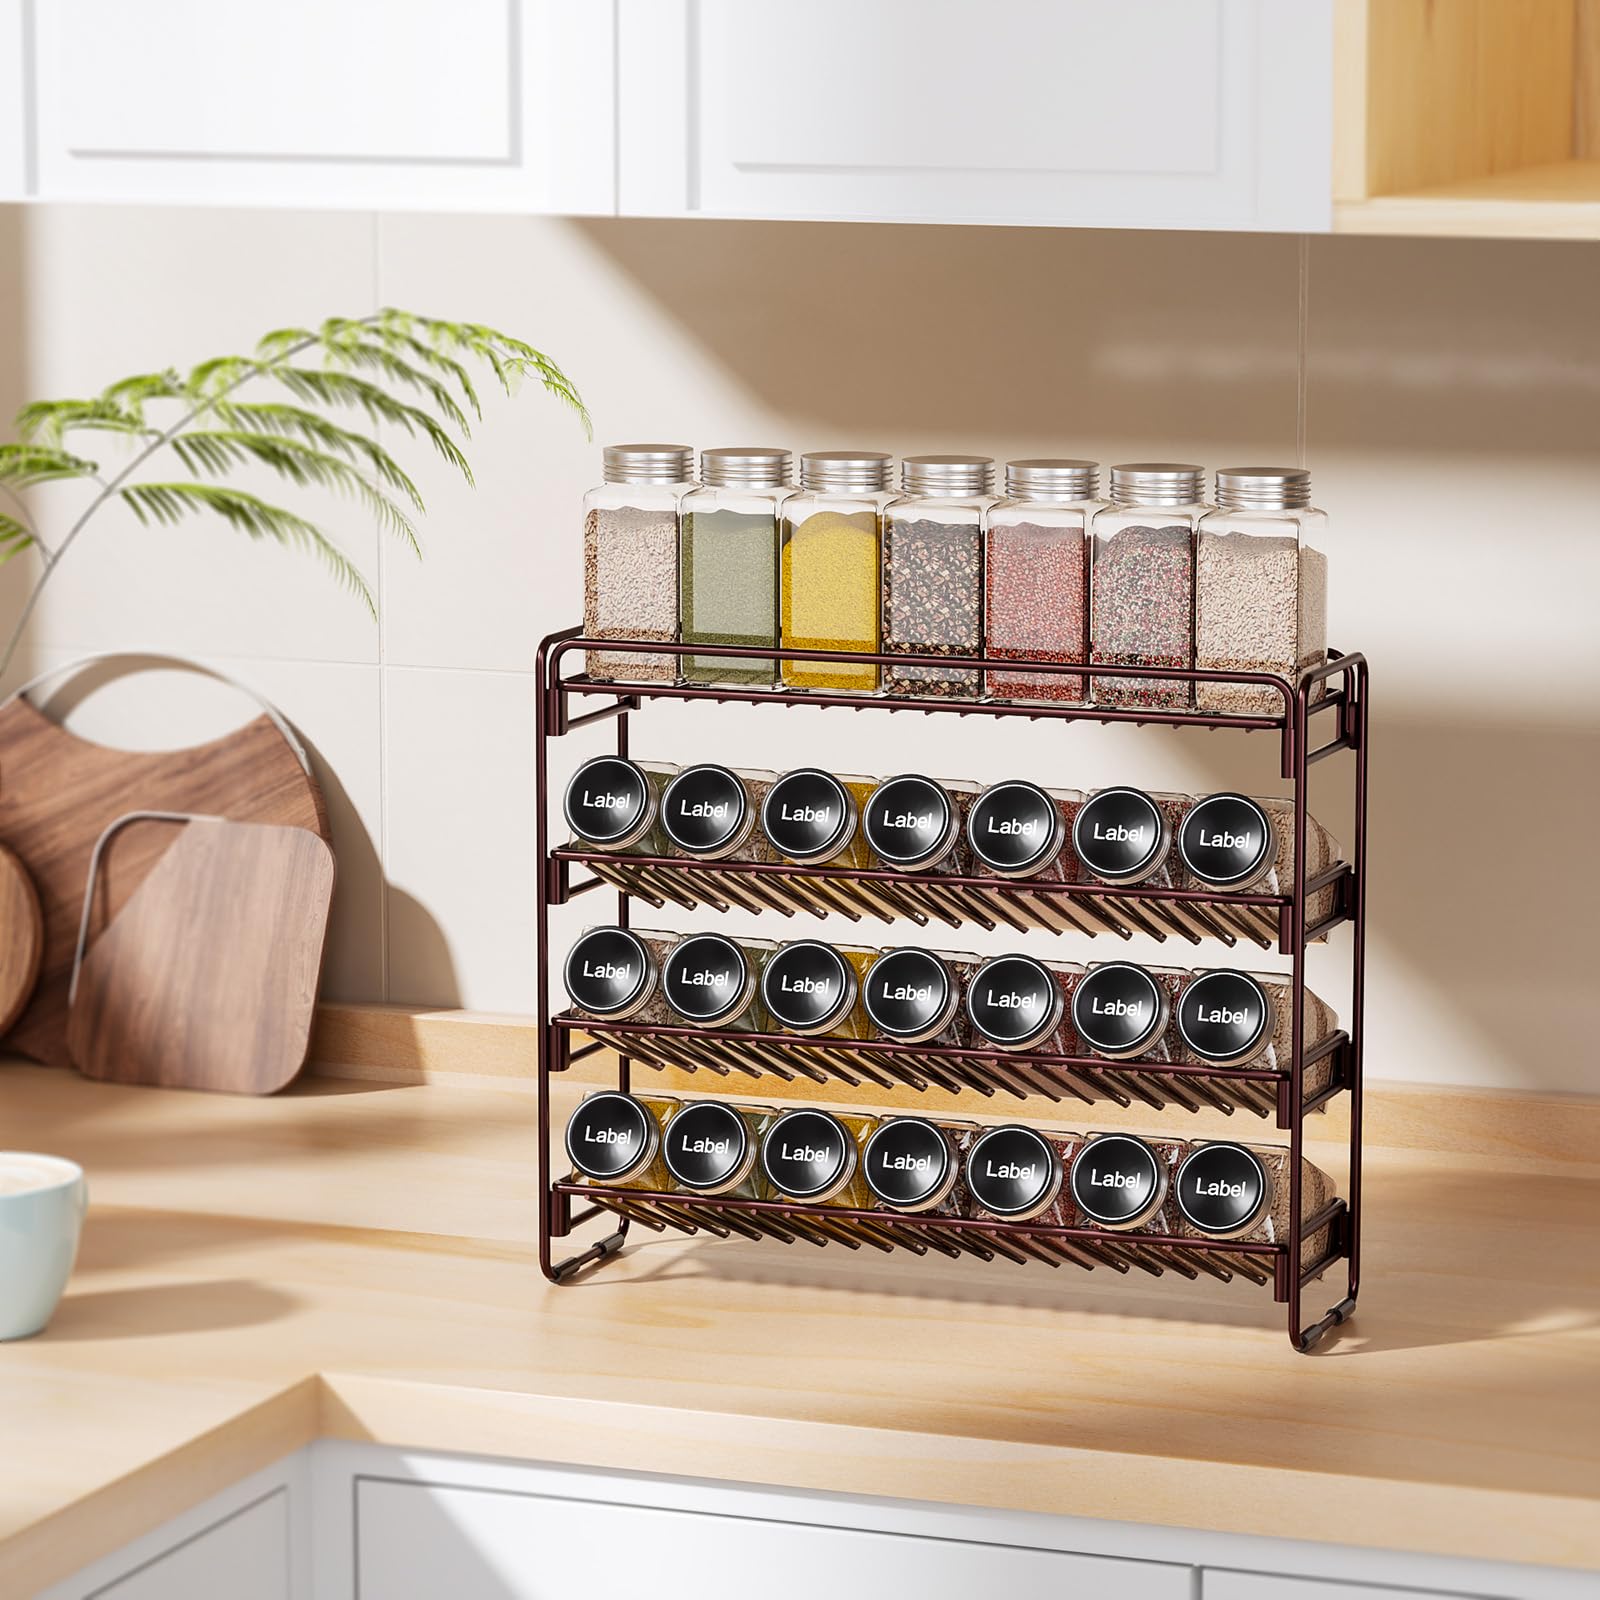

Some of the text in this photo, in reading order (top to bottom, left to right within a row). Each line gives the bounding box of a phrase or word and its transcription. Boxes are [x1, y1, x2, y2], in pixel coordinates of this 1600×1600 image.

[583, 790, 631, 809] Label
[681, 800, 729, 818] Label
[781, 804, 831, 823] Label
[883, 810, 933, 829] Label
[988, 816, 1038, 836] Label
[1094, 823, 1144, 842] Label
[1200, 829, 1251, 849] Label
[583, 961, 631, 979] Label
[681, 968, 730, 987] Label
[781, 975, 830, 994] Label
[883, 982, 932, 1001] Label
[987, 989, 1037, 1009] Label
[1092, 997, 1143, 1017] Label
[1198, 1005, 1249, 1025] Label
[585, 1125, 632, 1145] Label
[682, 1135, 730, 1154] Label
[781, 1143, 830, 1163] Label
[883, 1152, 932, 1171] Label
[986, 1160, 1036, 1180] Label
[1091, 1168, 1141, 1189] Label
[1196, 1177, 1247, 1198] Label
